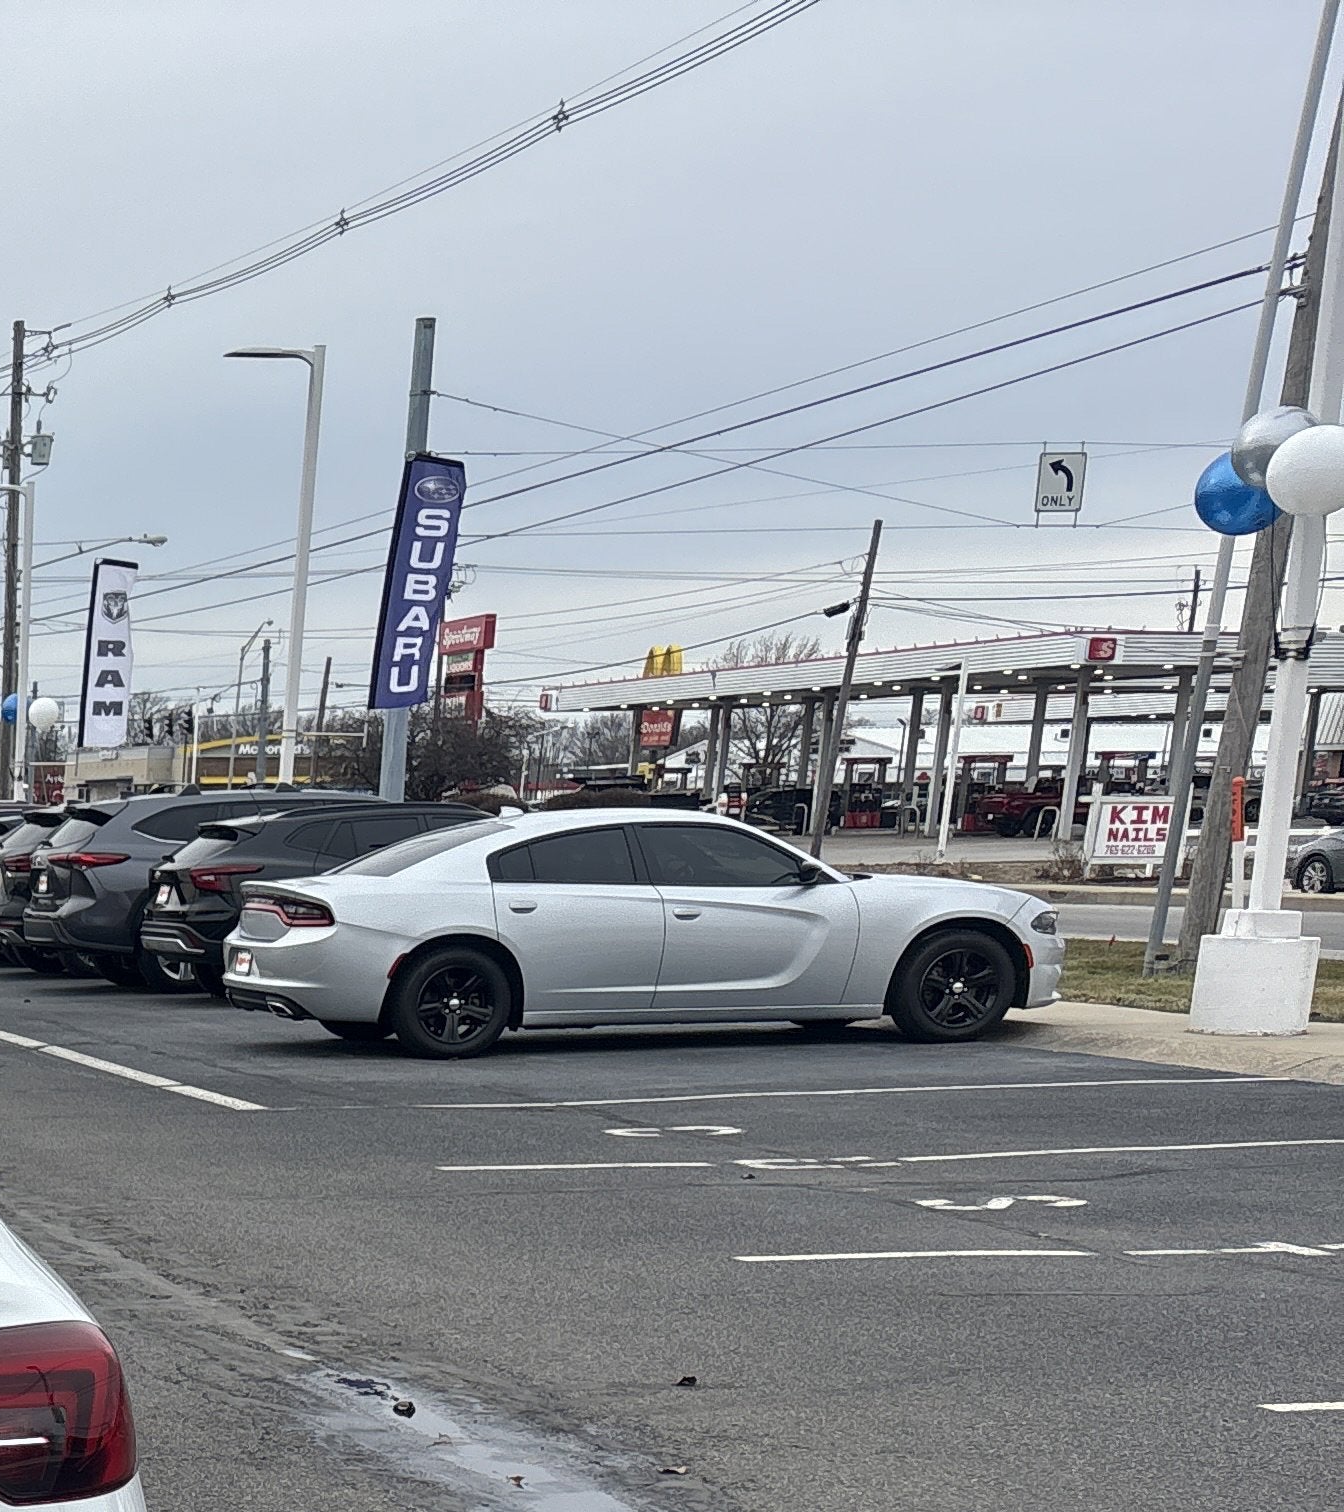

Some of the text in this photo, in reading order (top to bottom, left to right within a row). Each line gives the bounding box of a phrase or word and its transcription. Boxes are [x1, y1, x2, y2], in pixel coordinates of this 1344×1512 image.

[1041, 495, 1075, 507] ONLY
[389, 508, 451, 693] SUBARU
[92, 640, 126, 716] RAM
[1109, 805, 1170, 825] KIM
[1106, 827, 1167, 842] NAILS
